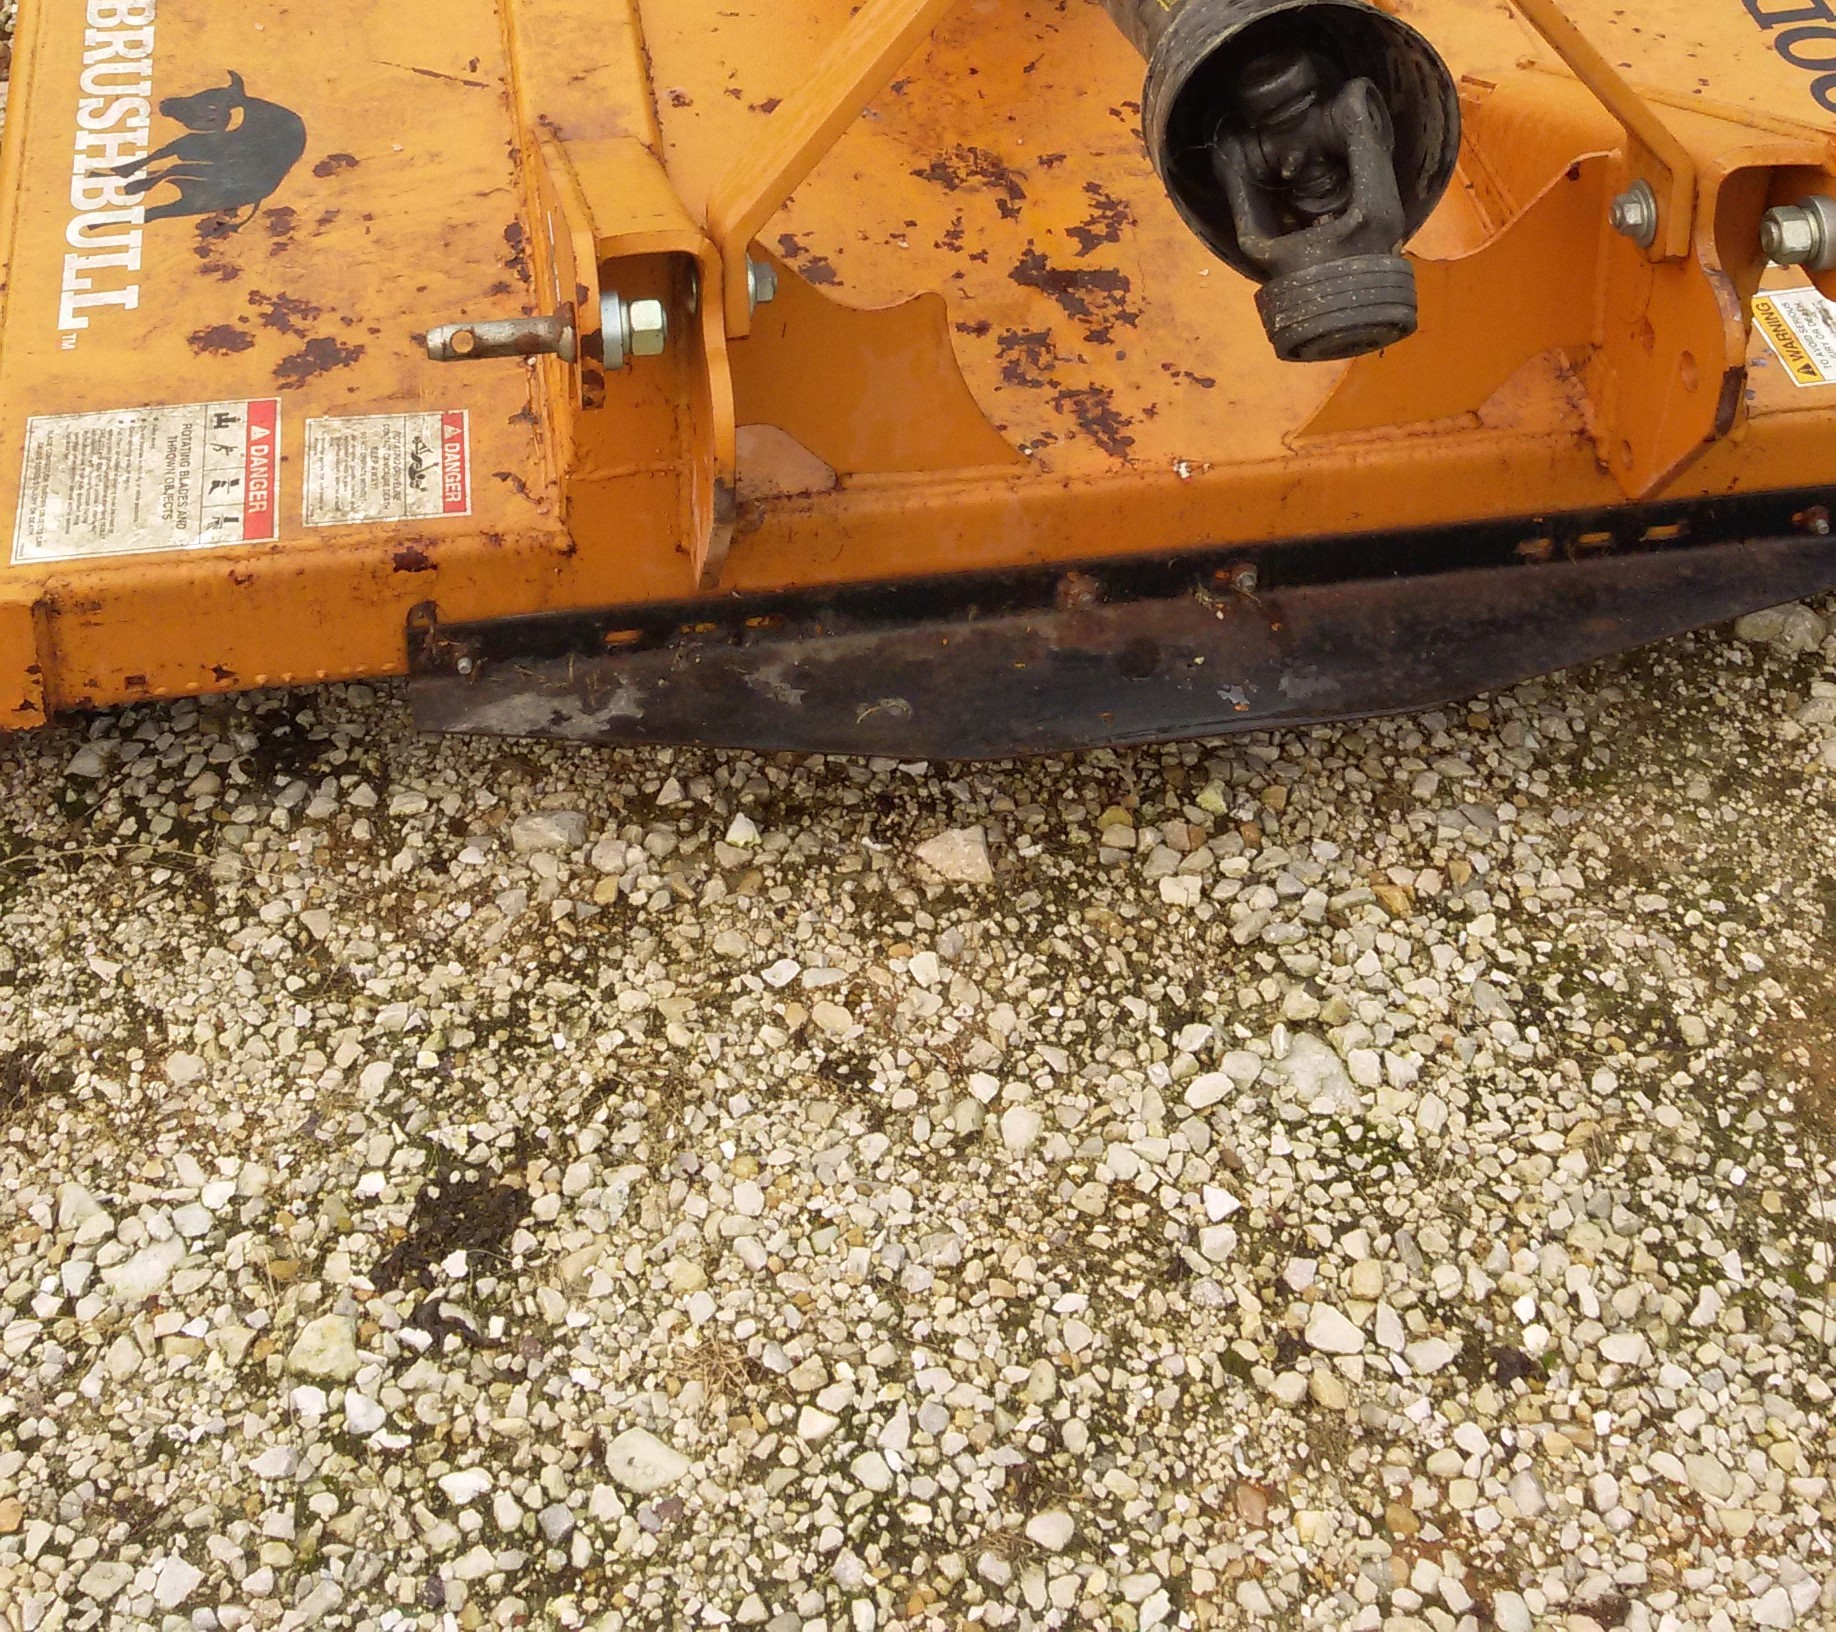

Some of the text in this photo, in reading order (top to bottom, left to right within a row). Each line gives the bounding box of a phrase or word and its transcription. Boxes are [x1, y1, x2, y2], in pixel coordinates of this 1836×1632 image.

[1755, 302, 1805, 363] WARNING
[1781, 301, 1808, 334] SERIOUS
[1803, 335, 1825, 358] AVOID
[162, 435, 178, 521] THROWN OBJECTS
[175, 423, 193, 530] ROTATING BLADES AND
[248, 444, 269, 514] DANGER
[443, 442, 462, 503] DANGER
